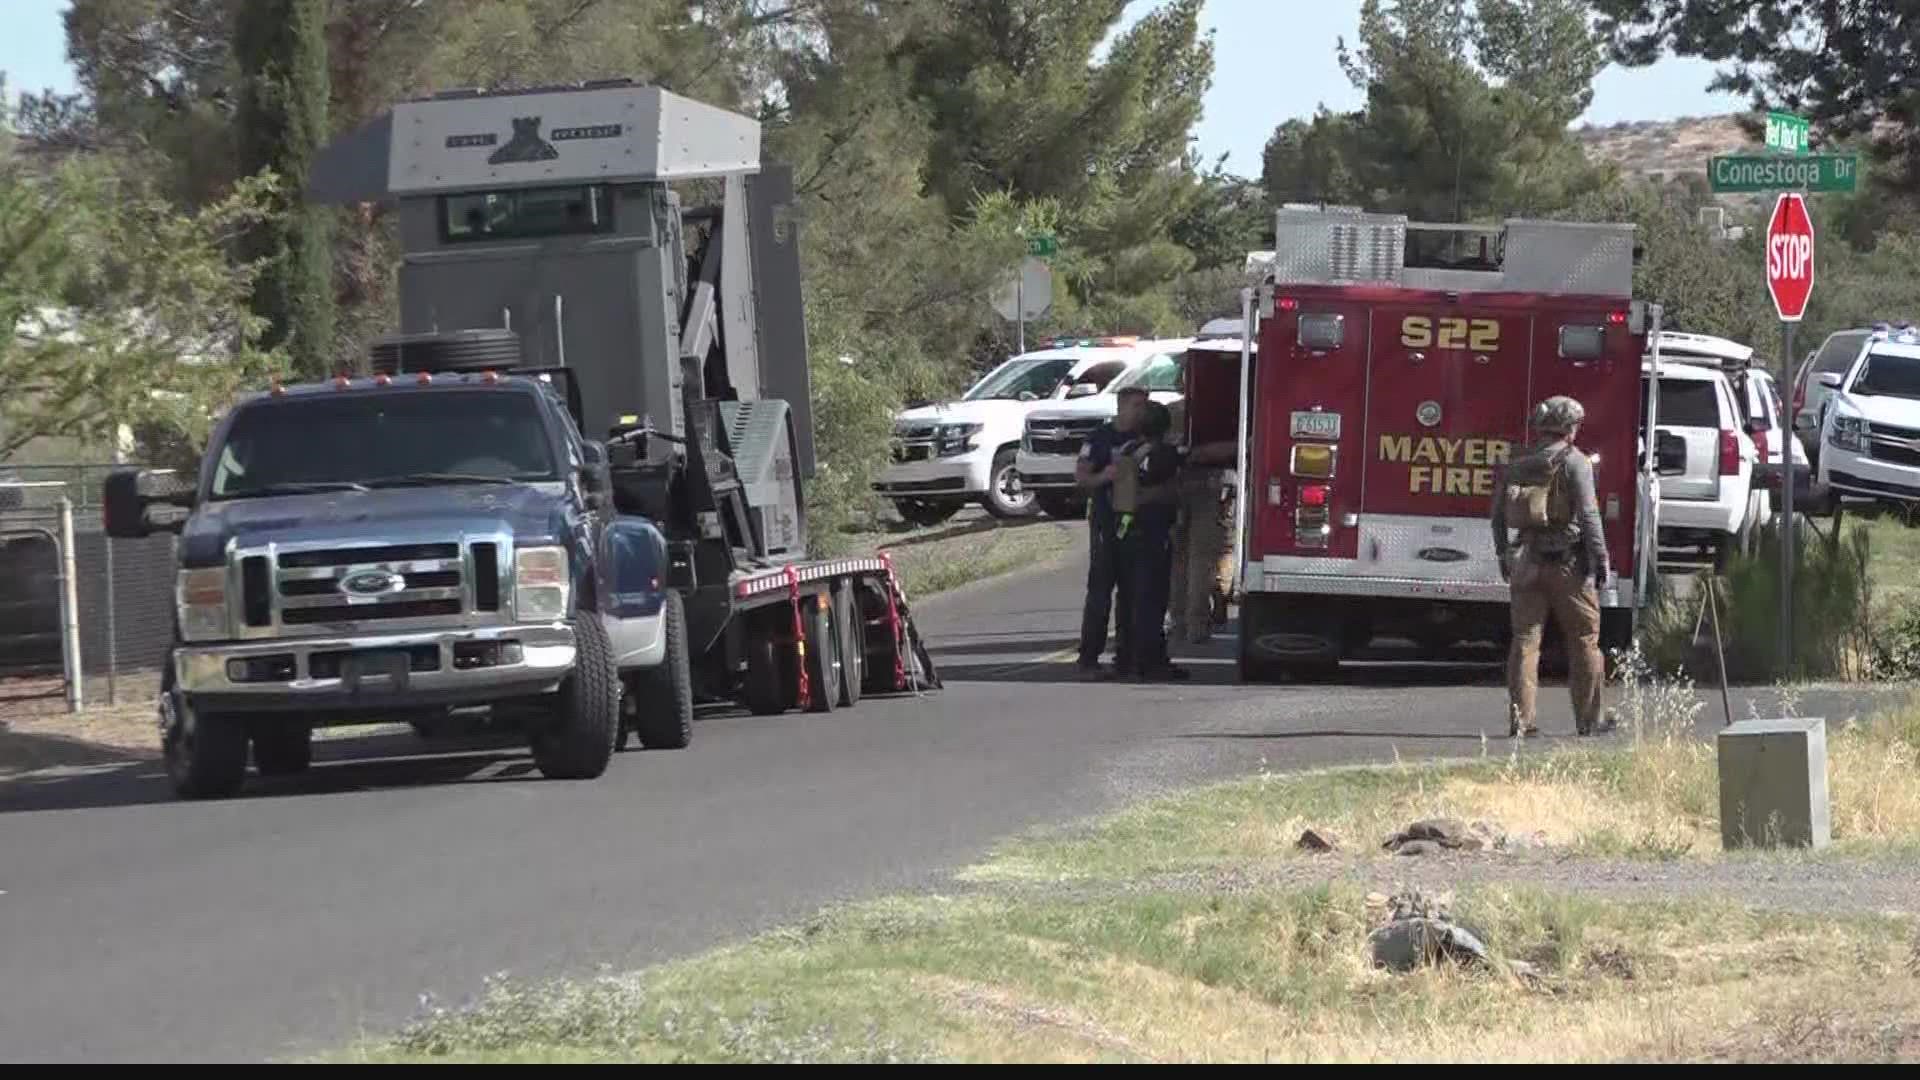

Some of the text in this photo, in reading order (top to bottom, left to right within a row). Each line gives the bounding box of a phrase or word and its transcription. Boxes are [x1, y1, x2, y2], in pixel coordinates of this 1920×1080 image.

[1717, 158, 1853, 189] Conestoga Dr
[1771, 234, 1810, 279] STOP
[1401, 316, 1500, 350] S22
[1379, 435, 1512, 464] MAYER
[1409, 466, 1495, 495] FIRE
